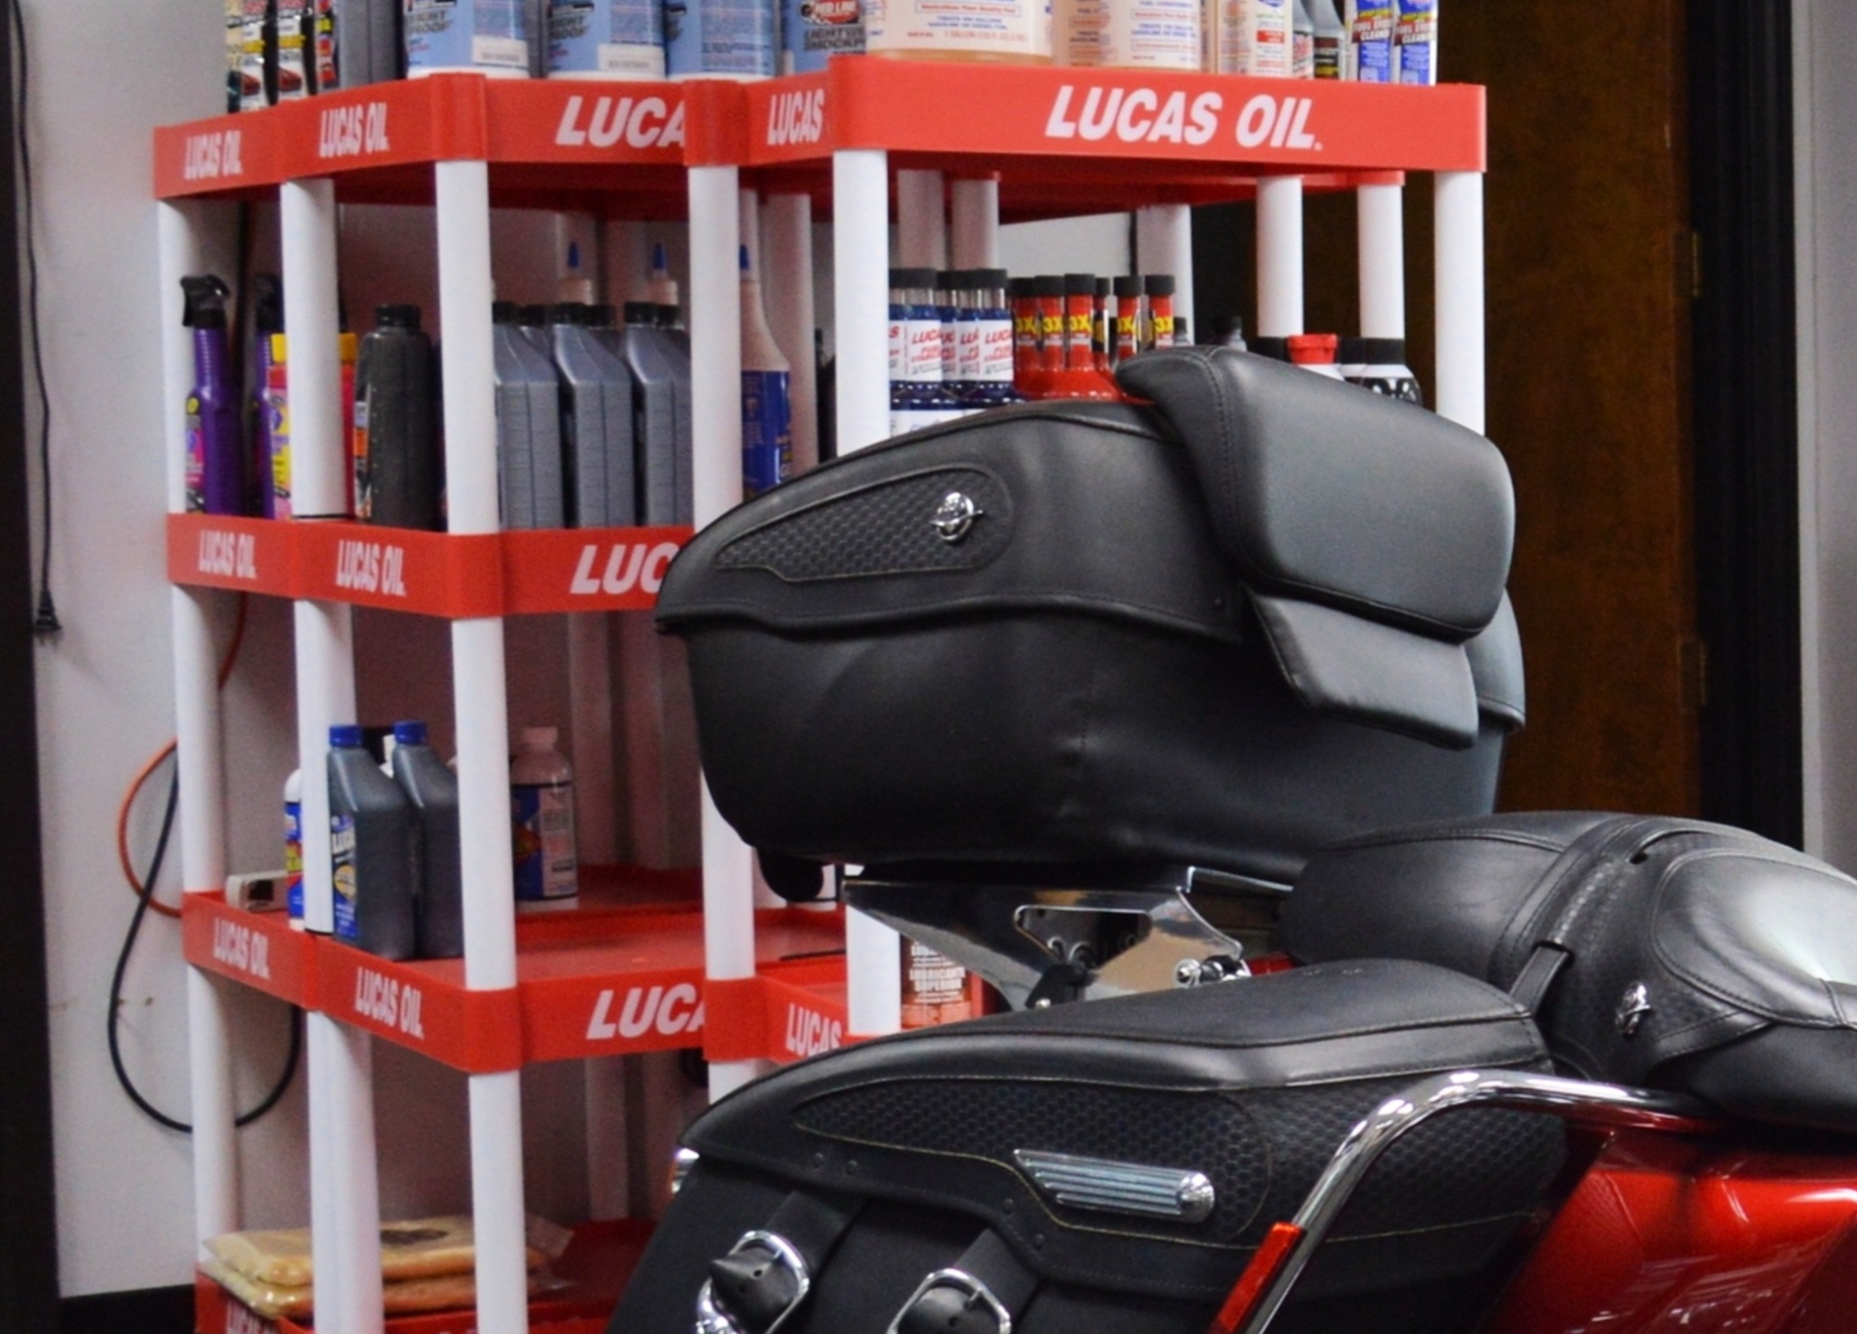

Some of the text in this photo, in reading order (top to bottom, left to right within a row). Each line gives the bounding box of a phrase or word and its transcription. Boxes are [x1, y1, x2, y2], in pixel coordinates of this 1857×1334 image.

[319, 102, 390, 158] LUCAS OIL
[555, 95, 685, 148] LUCA
[766, 88, 825, 146] LUCAS
[1045, 85, 1223, 145] LUCAS
[184, 130, 243, 180] LUCAS OIL
[1069, 316, 1093, 334] 3X
[198, 530, 258, 579] LUCAS OIL
[336, 539, 406, 597] LUCAS OIL
[569, 542, 680, 595] LUC
[214, 917, 271, 980] LUCAS OIL
[355, 966, 425, 1041] LUCAS OIL
[785, 1002, 842, 1059] LUCAS
